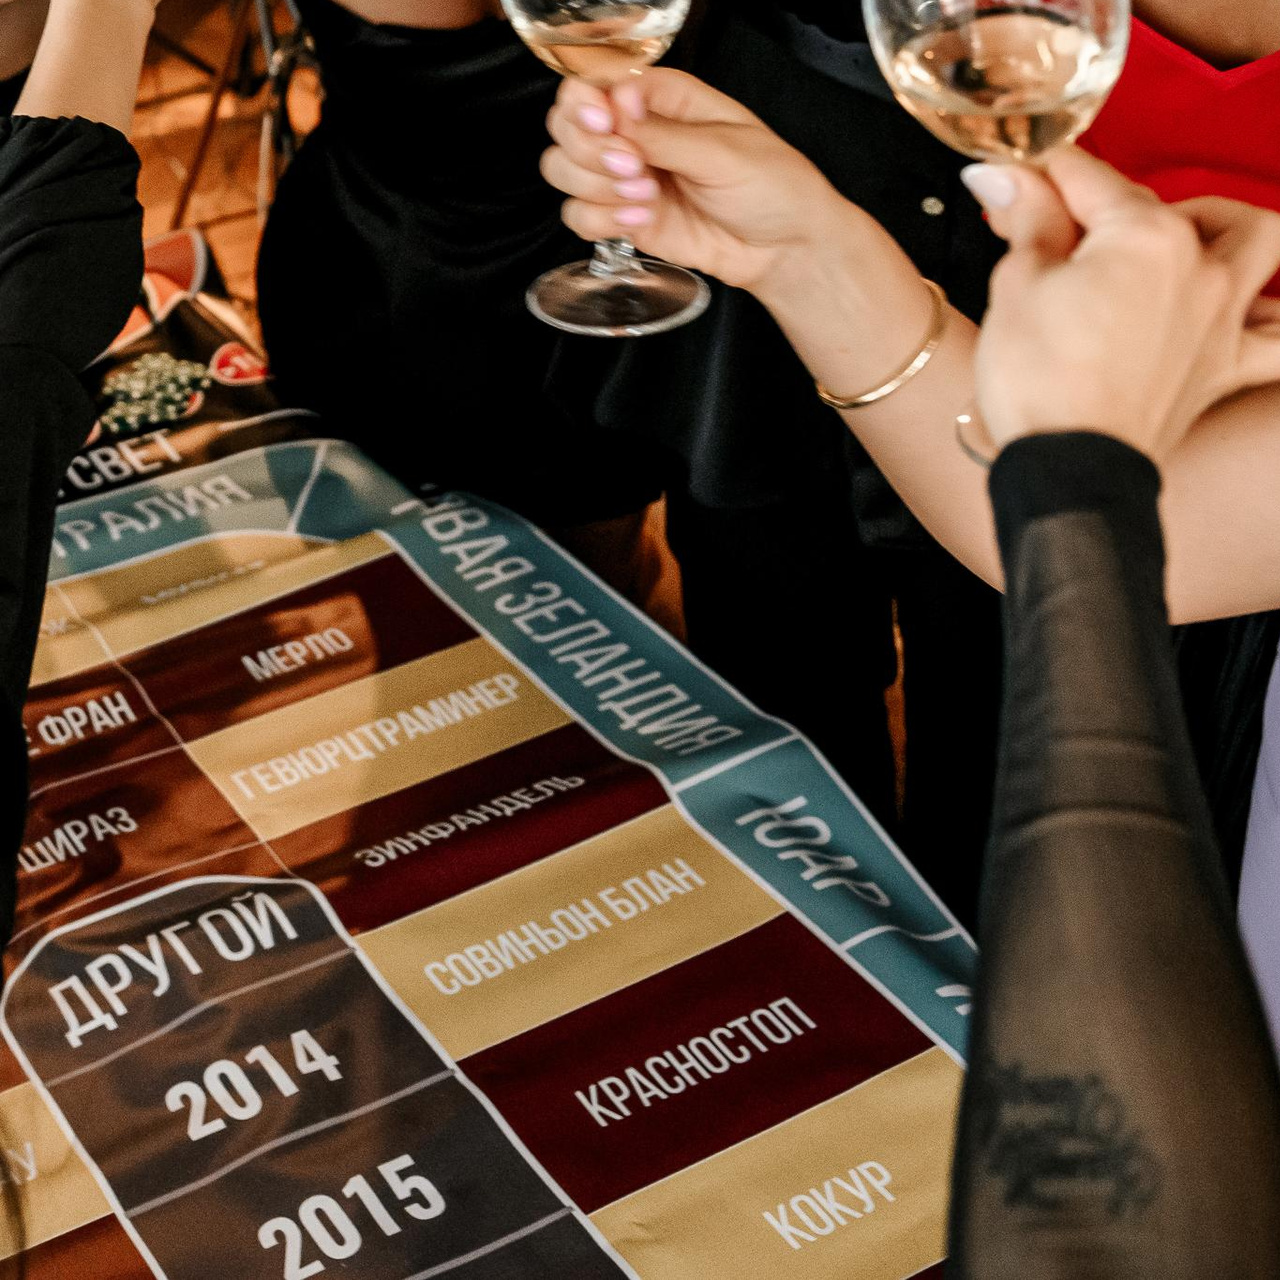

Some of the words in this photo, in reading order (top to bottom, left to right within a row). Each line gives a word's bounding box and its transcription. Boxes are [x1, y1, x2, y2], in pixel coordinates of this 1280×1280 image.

[67, 428, 182, 490] СВЕТ
[240, 626, 353, 683] МЕРЛО
[494, 581, 744, 756] ЗЕЛАНДИЯ
[37, 690, 138, 746] ФРАН
[230, 673, 521, 800] ГЕВЮРЦТРАМИНЕР
[17, 806, 139, 873] ШИРАЗ
[353, 775, 586, 868] ЗИНФАНДЕЛЬ
[734, 795, 892, 909] ЮАР
[47, 891, 298, 1049] ДРУГОЙ
[422, 896, 612, 996] СОВИНЬОН
[598, 857, 706, 925] БЛАН
[165, 1029, 343, 1141] 2014
[574, 996, 818, 1128] КРАСНОСТОП
[257, 1154, 447, 1280] 2015
[762, 1160, 897, 1251] КОКУР
